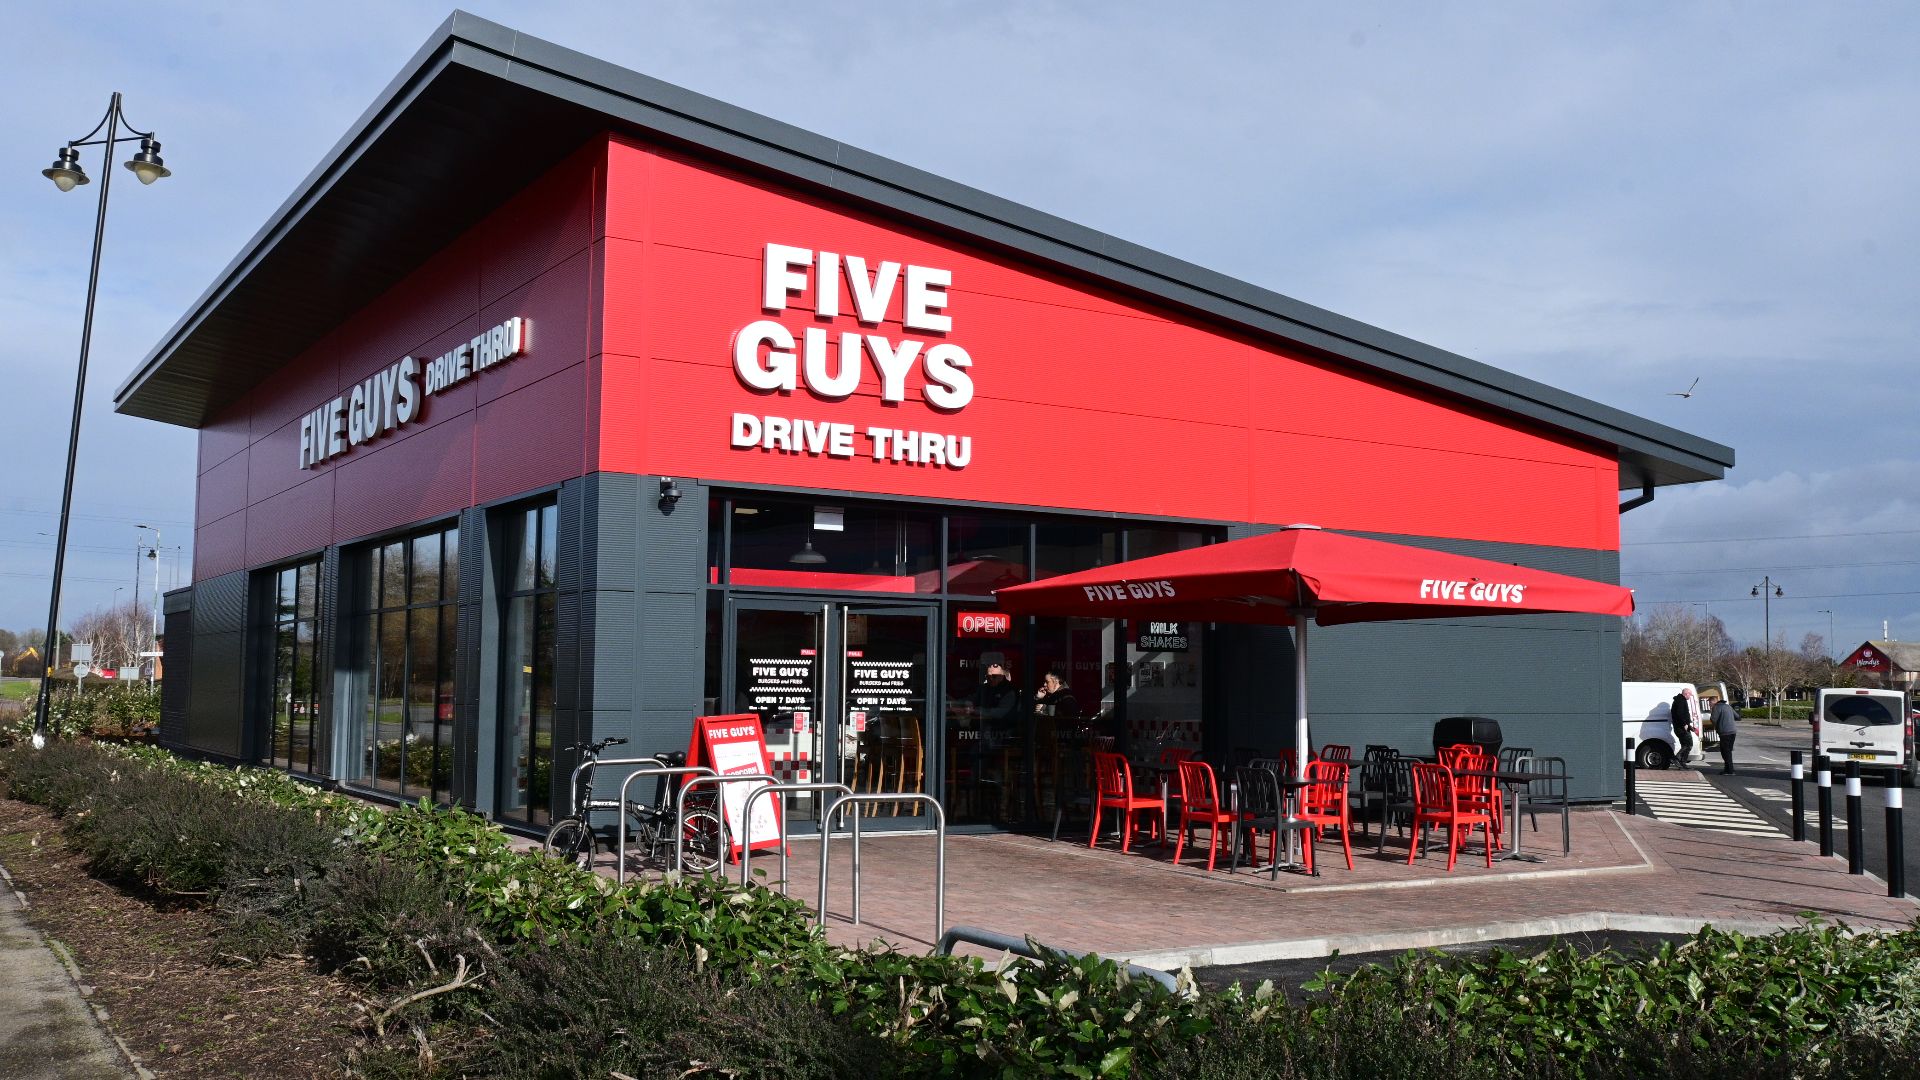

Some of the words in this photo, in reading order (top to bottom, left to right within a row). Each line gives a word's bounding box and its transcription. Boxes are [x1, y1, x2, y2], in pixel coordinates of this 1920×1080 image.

[762, 243, 952, 332] FIVE
[425, 343, 471, 396] DRIVE
[470, 316, 523, 373] THRU
[733, 320, 975, 410] GUYS
[299, 397, 347, 470] FIVE
[348, 355, 421, 446] GUYS
[731, 412, 855, 457] DRIVE
[866, 427, 972, 468] THRU
[1083, 585, 1128, 602] FIVE
[1127, 580, 1176, 600] GUYS
[1420, 579, 1469, 600] FIVE
[1470, 582, 1526, 604] GUYS
[962, 615, 1006, 633] OPEN
[1150, 621, 1178, 635] MILK
[1140, 635, 1188, 649] SHAKES
[752, 667, 777, 677] FIVE
[778, 667, 809, 677] GUYS
[854, 669, 878, 679] FIVE
[880, 669, 910, 679] GUYS
[755, 696, 777, 704] OPEN
[778, 696, 784, 704] 7
[785, 696, 806, 704] DAYS
[856, 697, 878, 705] OPEN
[879, 697, 885, 705] 7
[886, 697, 907, 705] DAYS
[708, 728, 729, 739] FIVE
[730, 725, 755, 738] GUYS
[958, 730, 981, 740] FIVE
